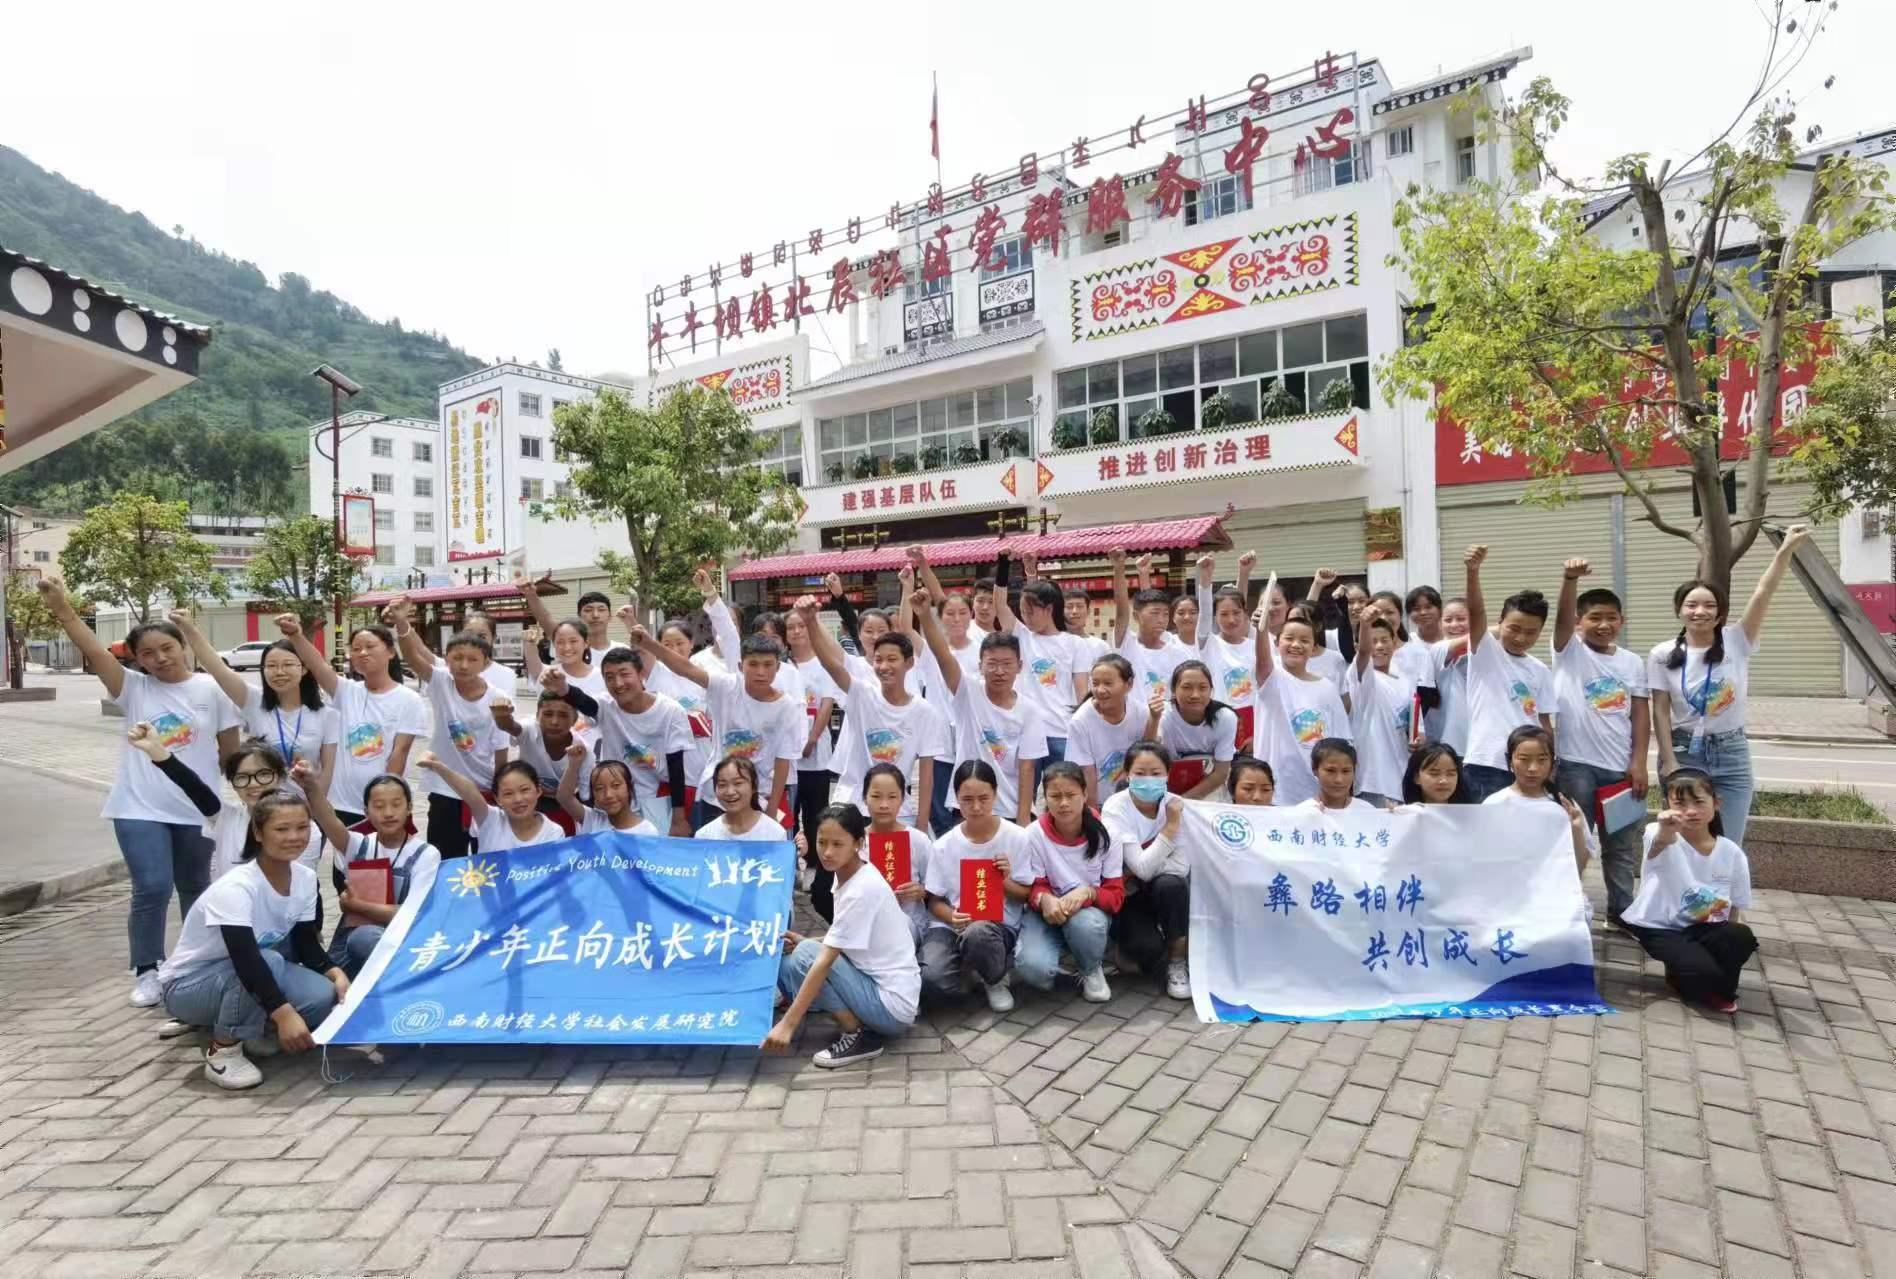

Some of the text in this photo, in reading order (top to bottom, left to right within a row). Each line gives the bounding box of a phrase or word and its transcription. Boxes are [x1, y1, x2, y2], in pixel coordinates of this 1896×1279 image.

[1098, 434, 1271, 480] 推进创新治理
[842, 479, 957, 511] 建强基层队伍
[1267, 828, 1391, 849] 西南财经大学
[568, 850, 606, 872] Youth
[611, 855, 699, 877] Development
[1264, 873, 1425, 916] 彝路相伴
[407, 913, 782, 971] 青少年正向成长计划
[1361, 928, 1528, 972] 共创成长
[448, 1009, 739, 1032] 西南财经大学社会发展研究院
